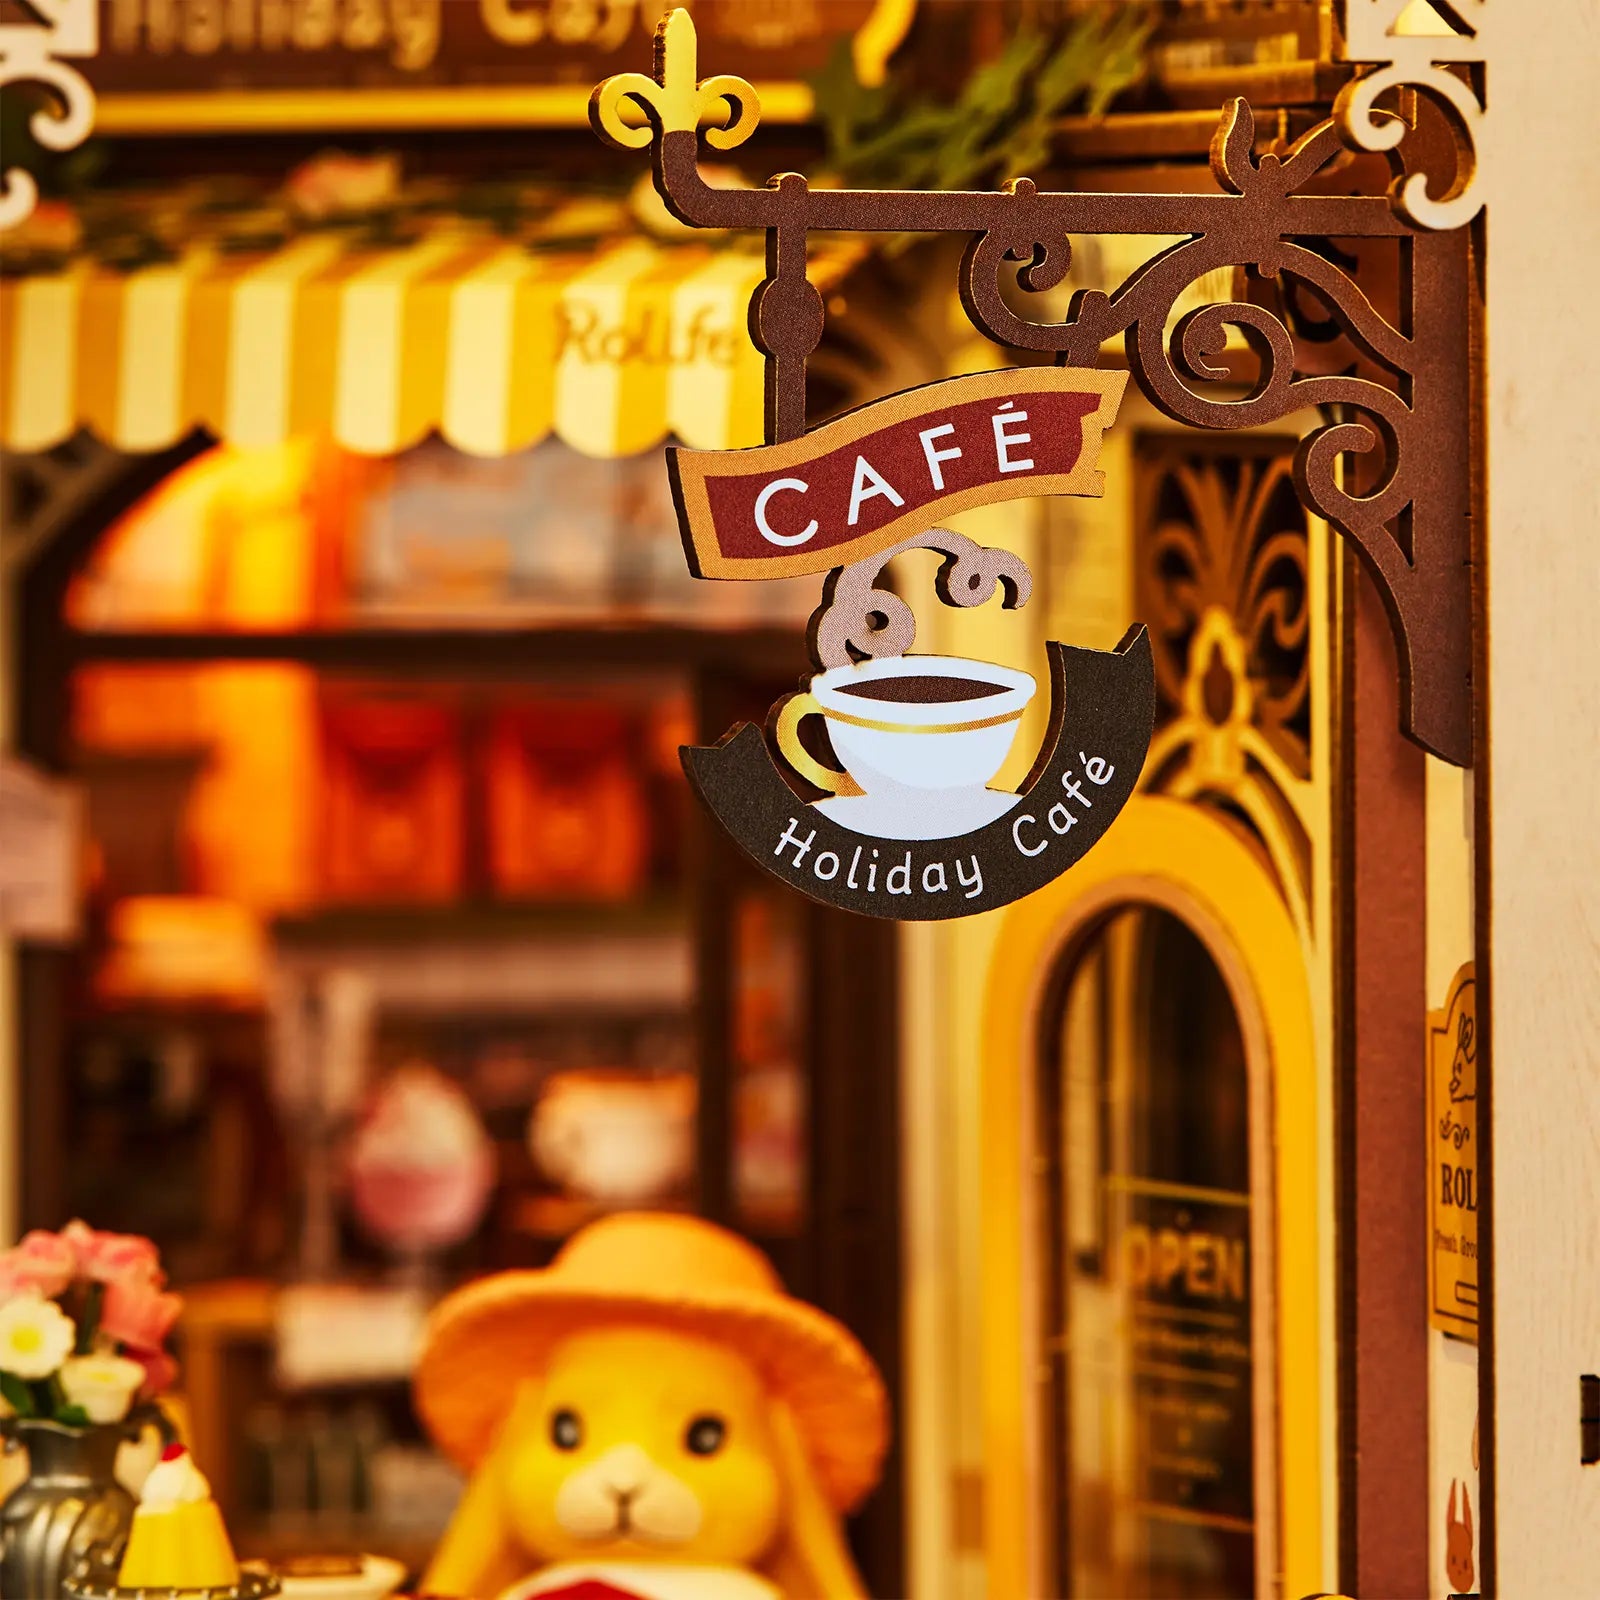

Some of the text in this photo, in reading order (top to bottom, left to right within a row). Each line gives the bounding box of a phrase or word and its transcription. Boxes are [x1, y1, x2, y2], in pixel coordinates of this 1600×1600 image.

[753, 400, 1036, 547] CAFÉ
[774, 751, 1116, 899] Holiday Café
[1121, 1225, 1245, 1299] OPEN
